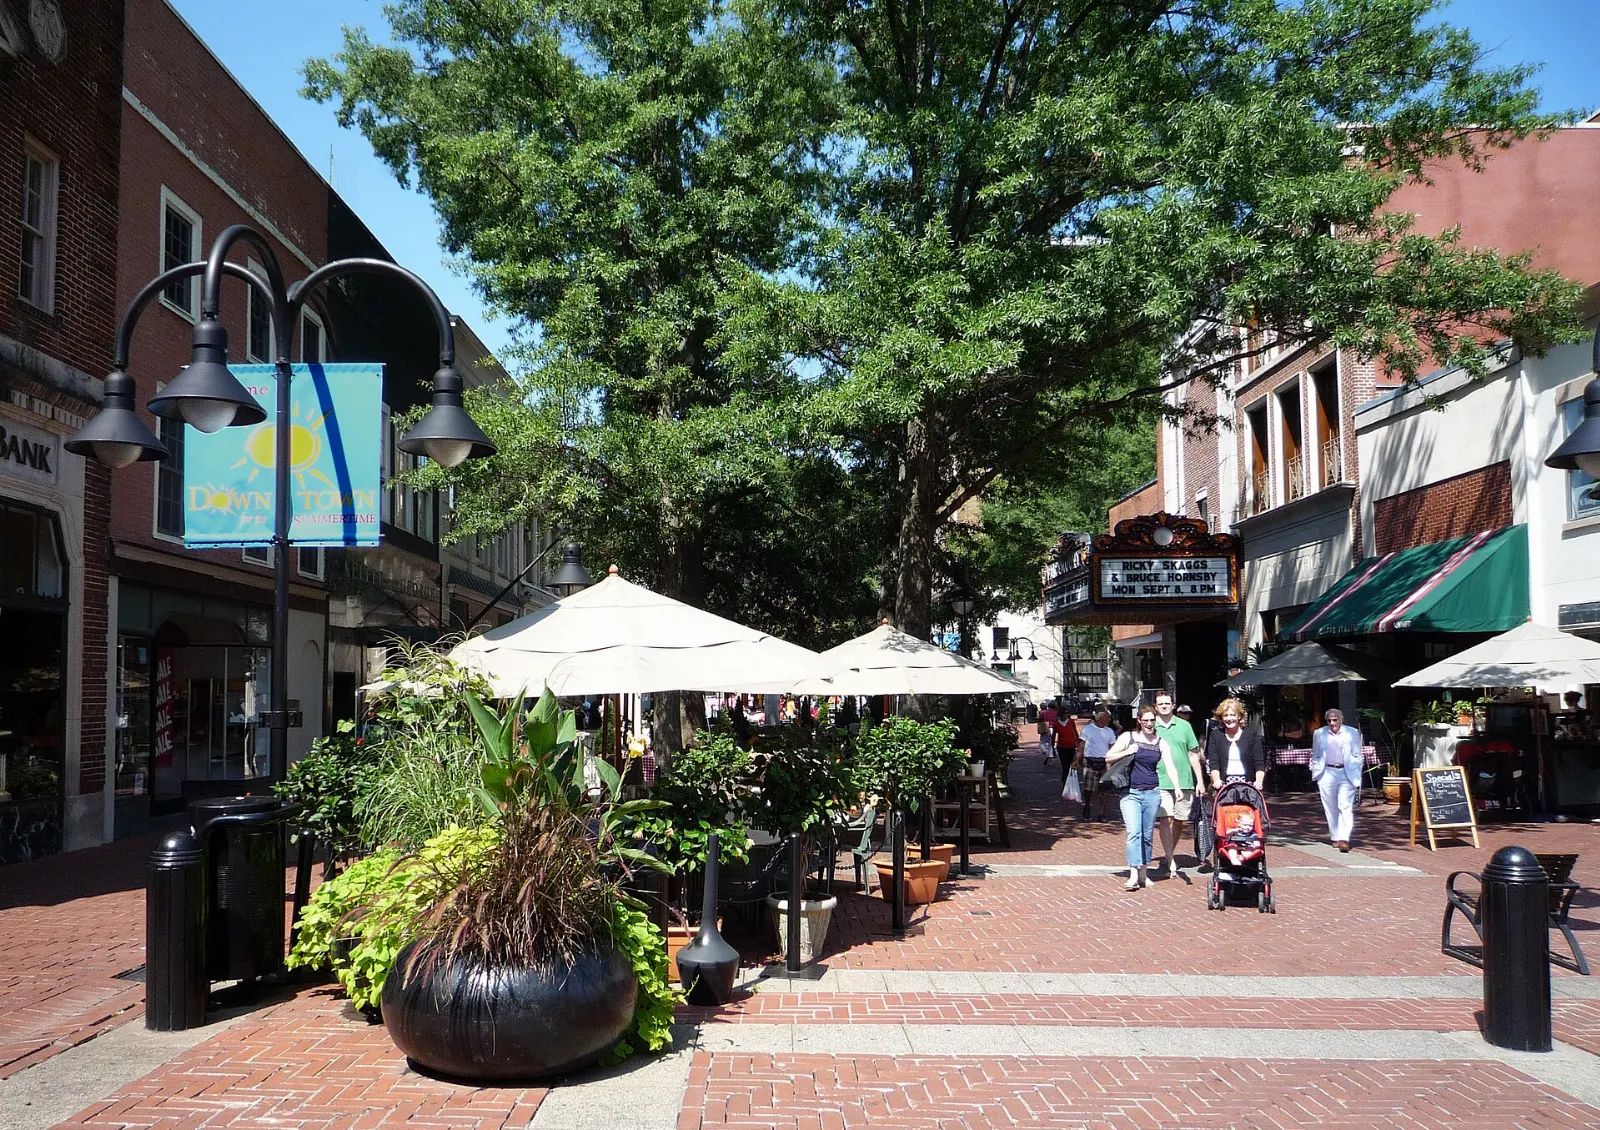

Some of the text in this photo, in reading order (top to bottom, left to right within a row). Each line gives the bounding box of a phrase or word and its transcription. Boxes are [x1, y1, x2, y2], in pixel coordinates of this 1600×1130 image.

[297, 489, 376, 510] TOWN
[293, 514, 376, 525] SUMMERTIME
[1122, 560, 1207, 570] RICKY SKAGGS
[1111, 572, 1217, 582] & BRUCE HORNSBY
[1112, 585, 1136, 594] MON
[1143, 585, 1170, 594] SEPT
